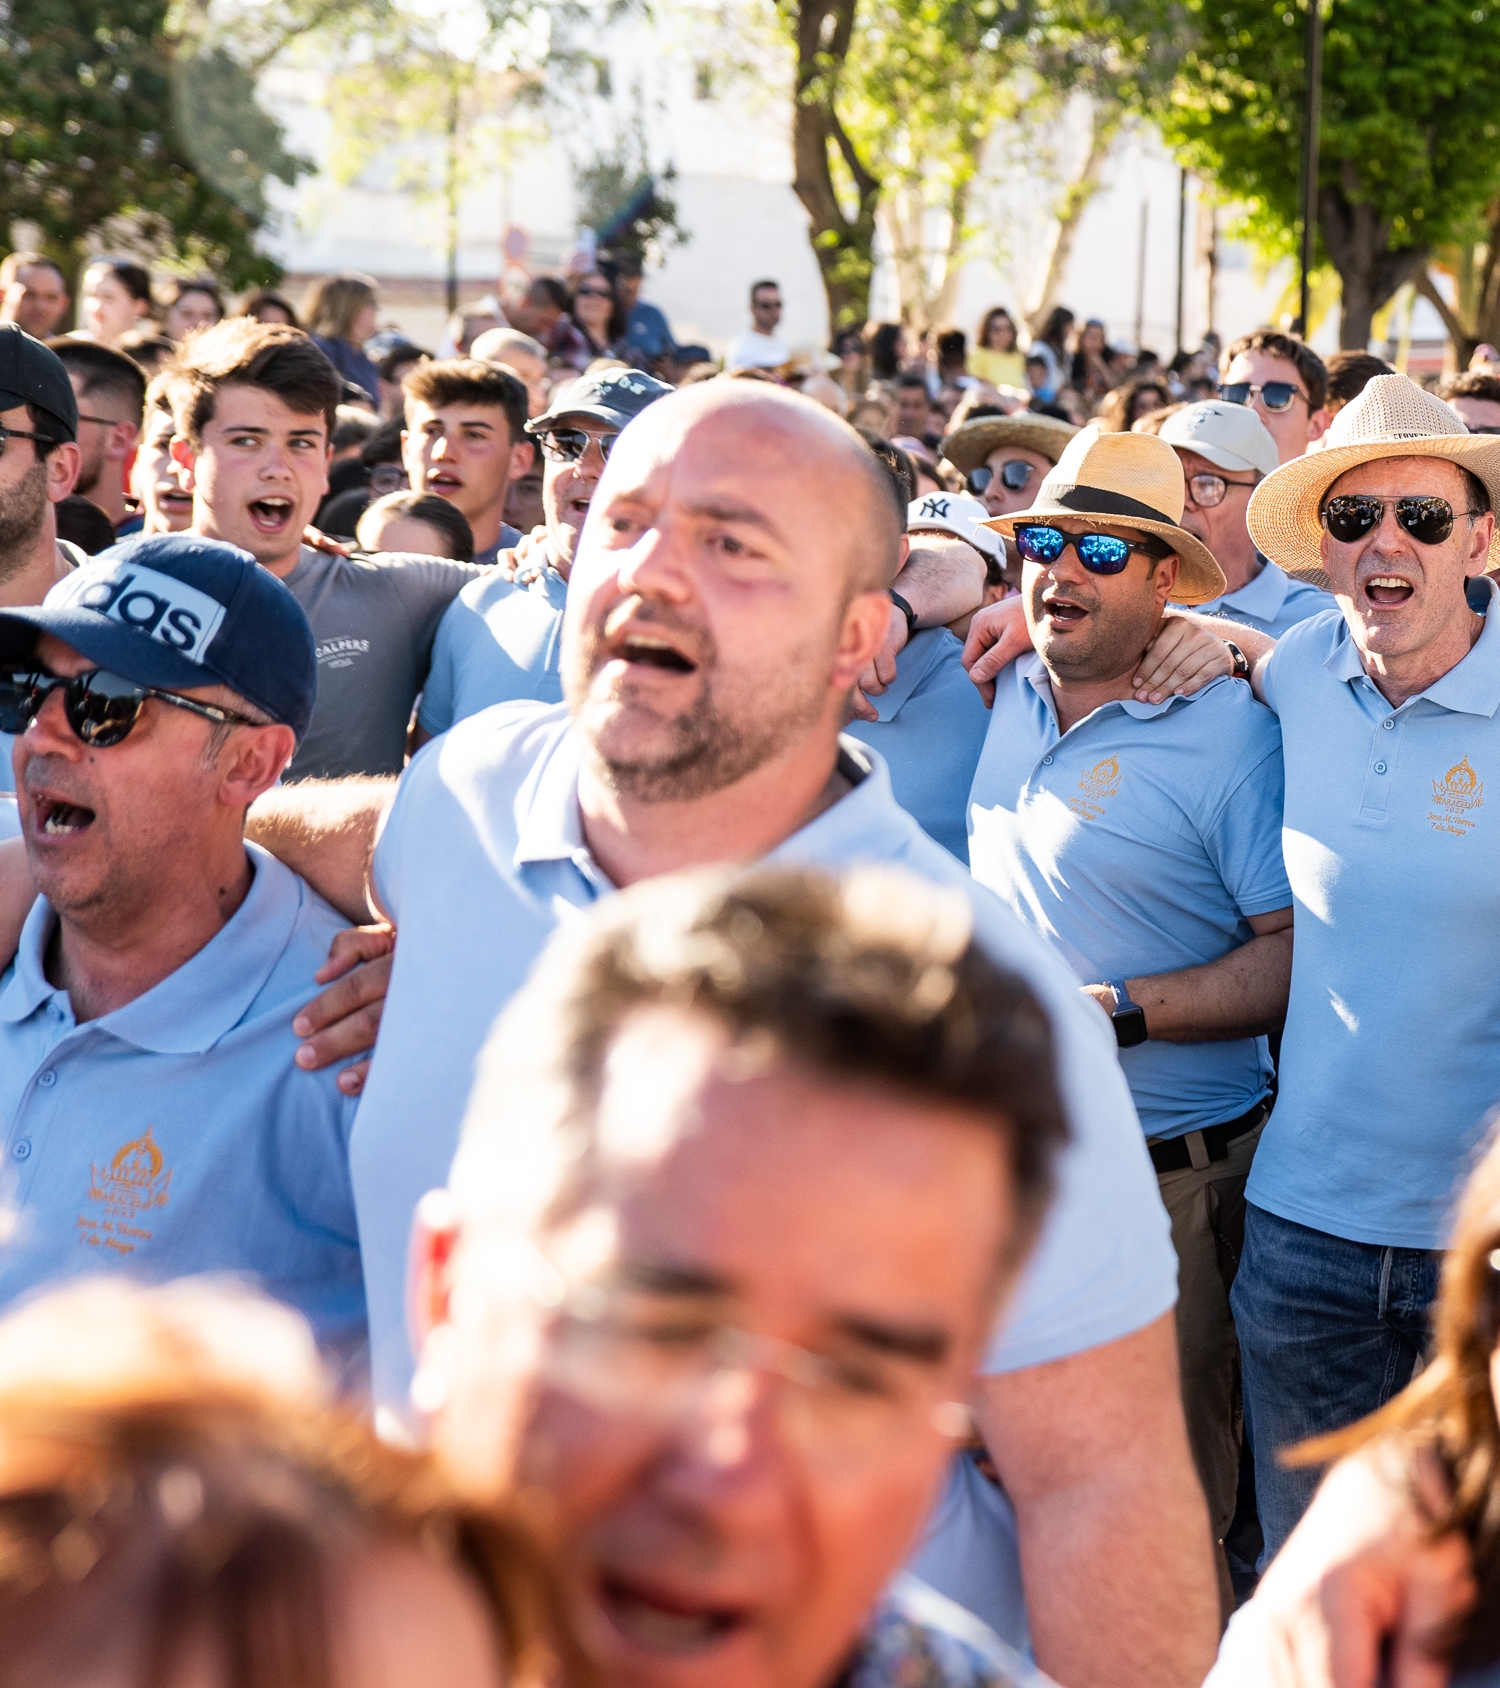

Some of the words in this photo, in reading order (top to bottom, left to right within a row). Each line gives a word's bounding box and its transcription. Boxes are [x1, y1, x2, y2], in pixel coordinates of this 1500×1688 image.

[919, 498, 951, 519] NY
[315, 639, 370, 658] CALPERS
[1445, 806, 1465, 814] 2023
[1453, 816, 1477, 827] Torres
[1436, 823, 1445, 831] de
[1446, 825, 1467, 836] Mayo
